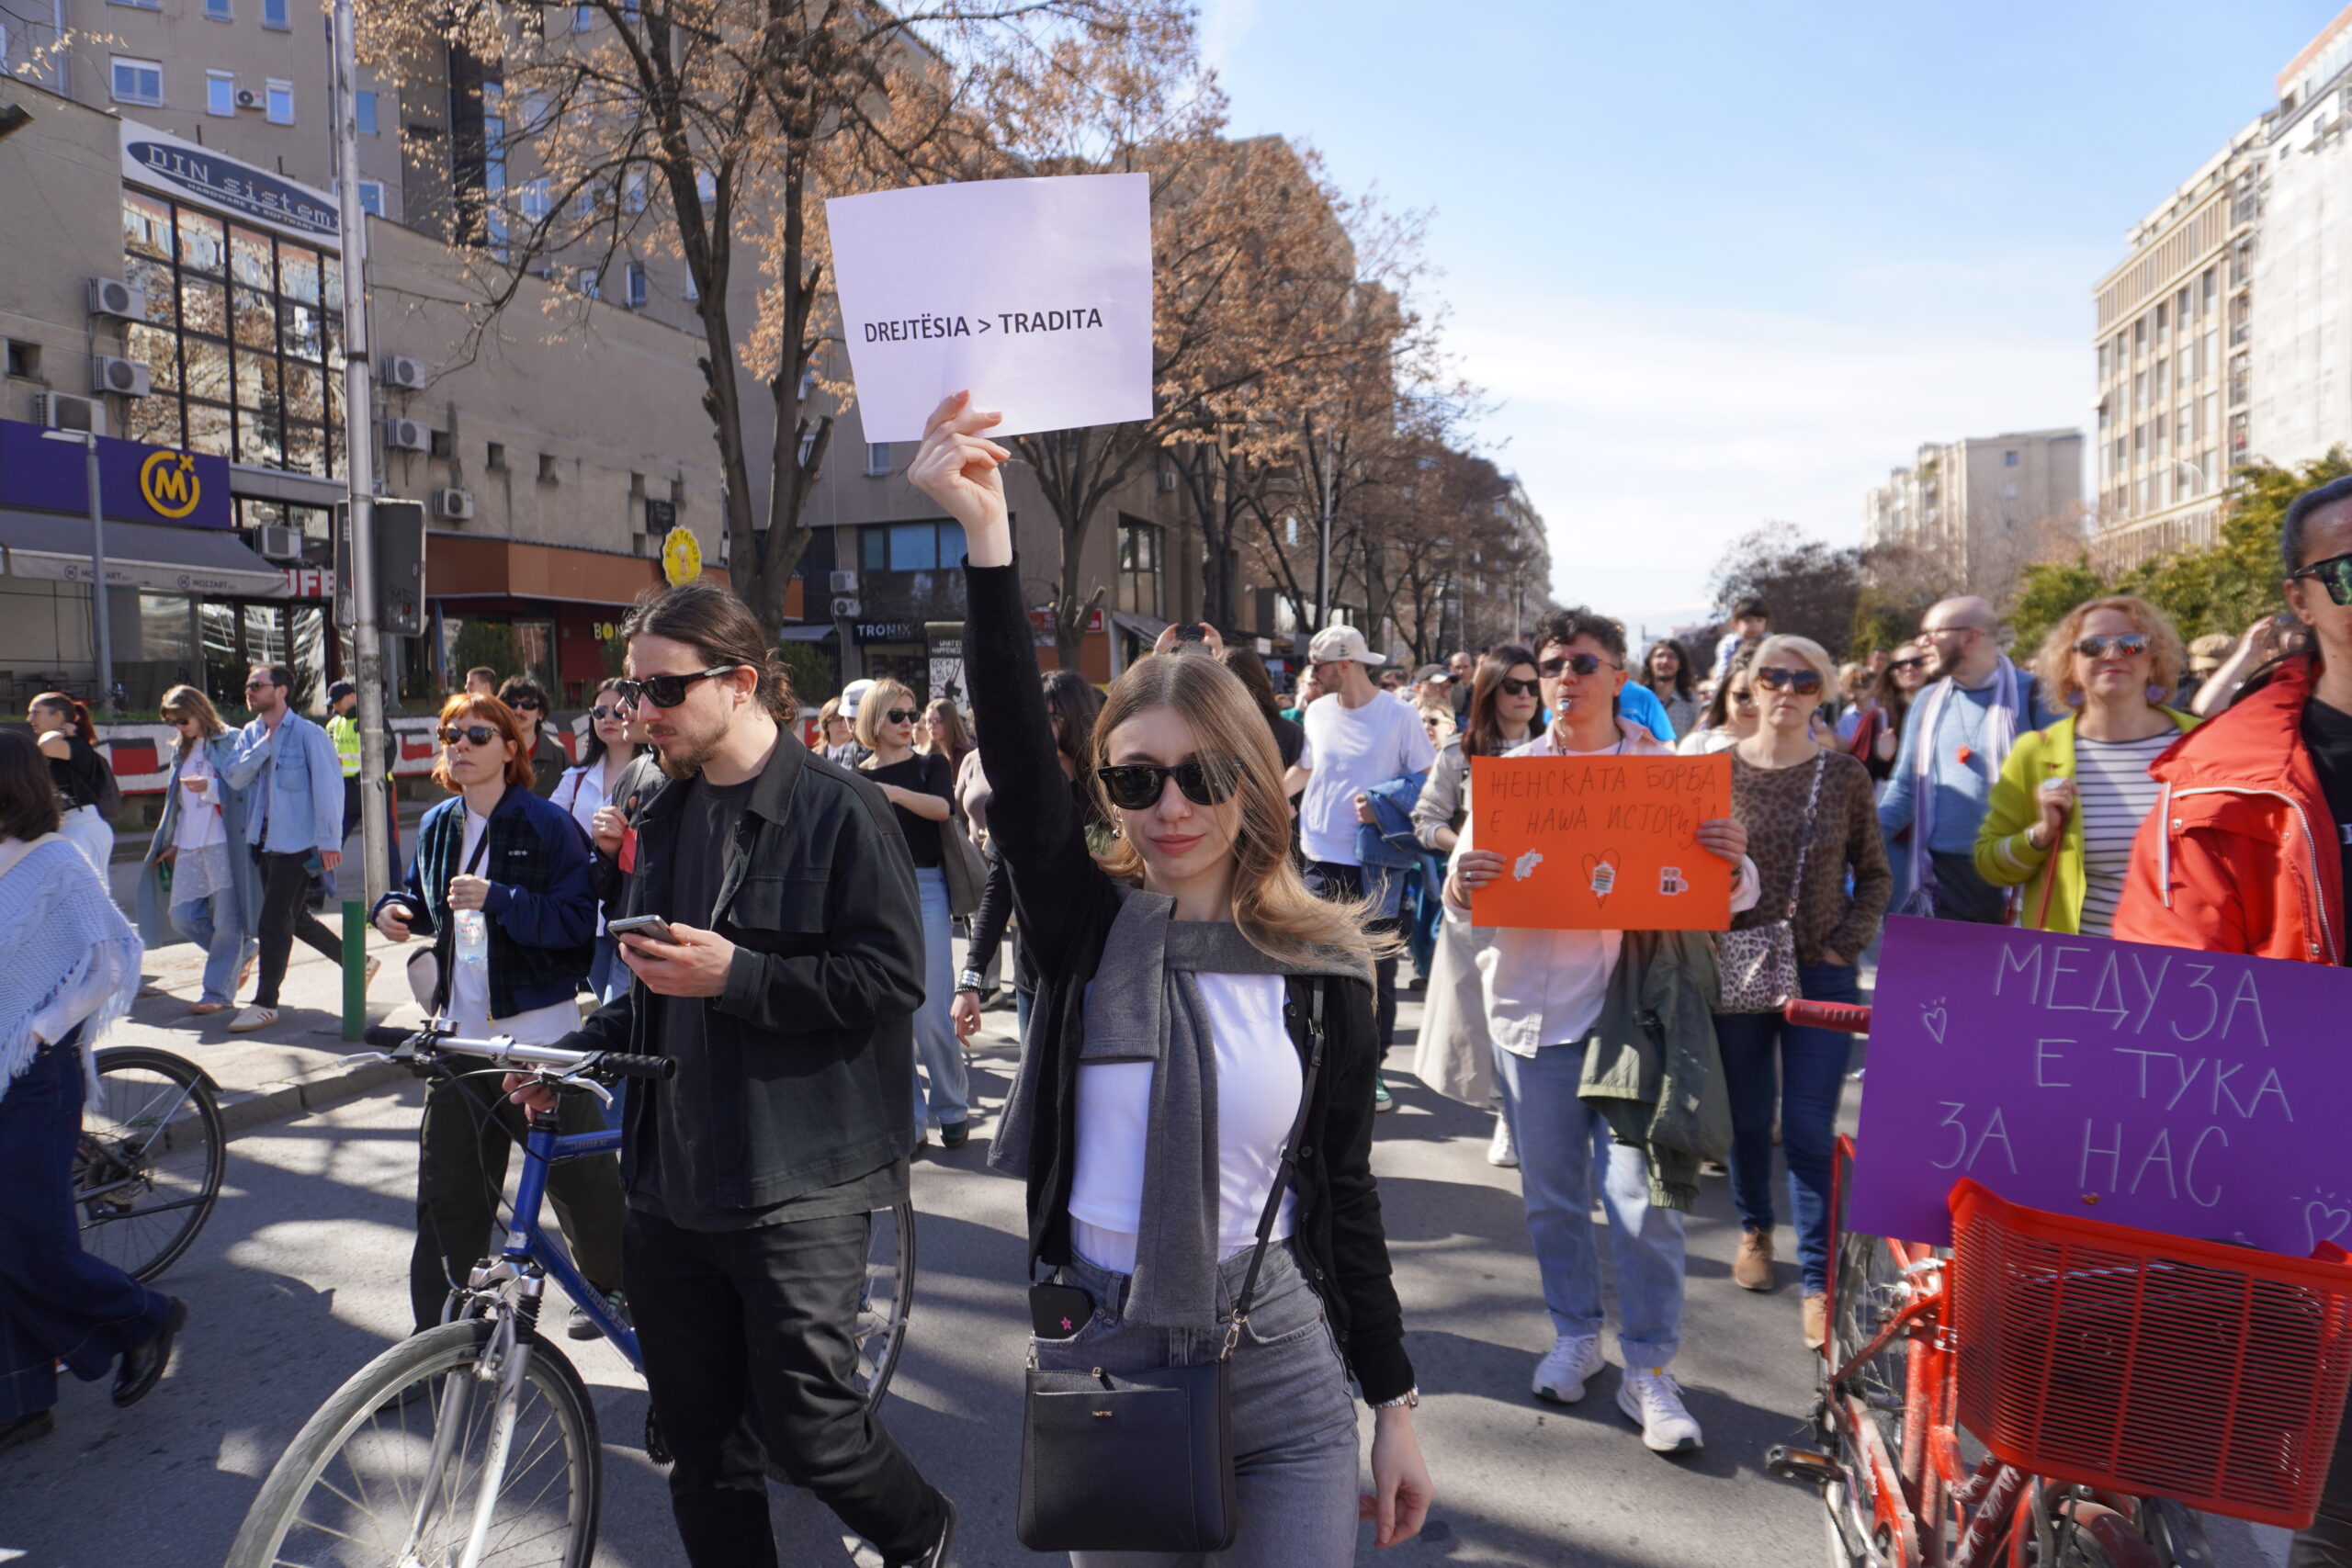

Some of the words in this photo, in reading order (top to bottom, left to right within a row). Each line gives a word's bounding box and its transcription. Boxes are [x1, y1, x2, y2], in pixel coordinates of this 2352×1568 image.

[148, 144, 209, 183] DIN
[187, 183, 246, 208] HARDWARE
[263, 209, 315, 231] SOFTWARE
[865, 313, 971, 343] DREJTËSIA
[978, 318, 991, 334] >
[999, 308, 1103, 333] TRADITA
[81, 569, 120, 581] MOART
[193, 579, 228, 589] MOZZART
[856, 624, 911, 637] TRONIX
[1491, 766, 1625, 800] ЖЕНСКАТА
[1645, 763, 1715, 795] БОРБА
[1490, 809, 1504, 832] Е
[1527, 805, 1588, 835] НАША
[1994, 942, 2269, 1046] МЕДУЗА
[2037, 1038, 2077, 1088] Е
[2114, 1047, 2294, 1122] ТУКА
[1931, 1101, 2017, 1174] ЗА
[2079, 1118, 2228, 1207] НАС
